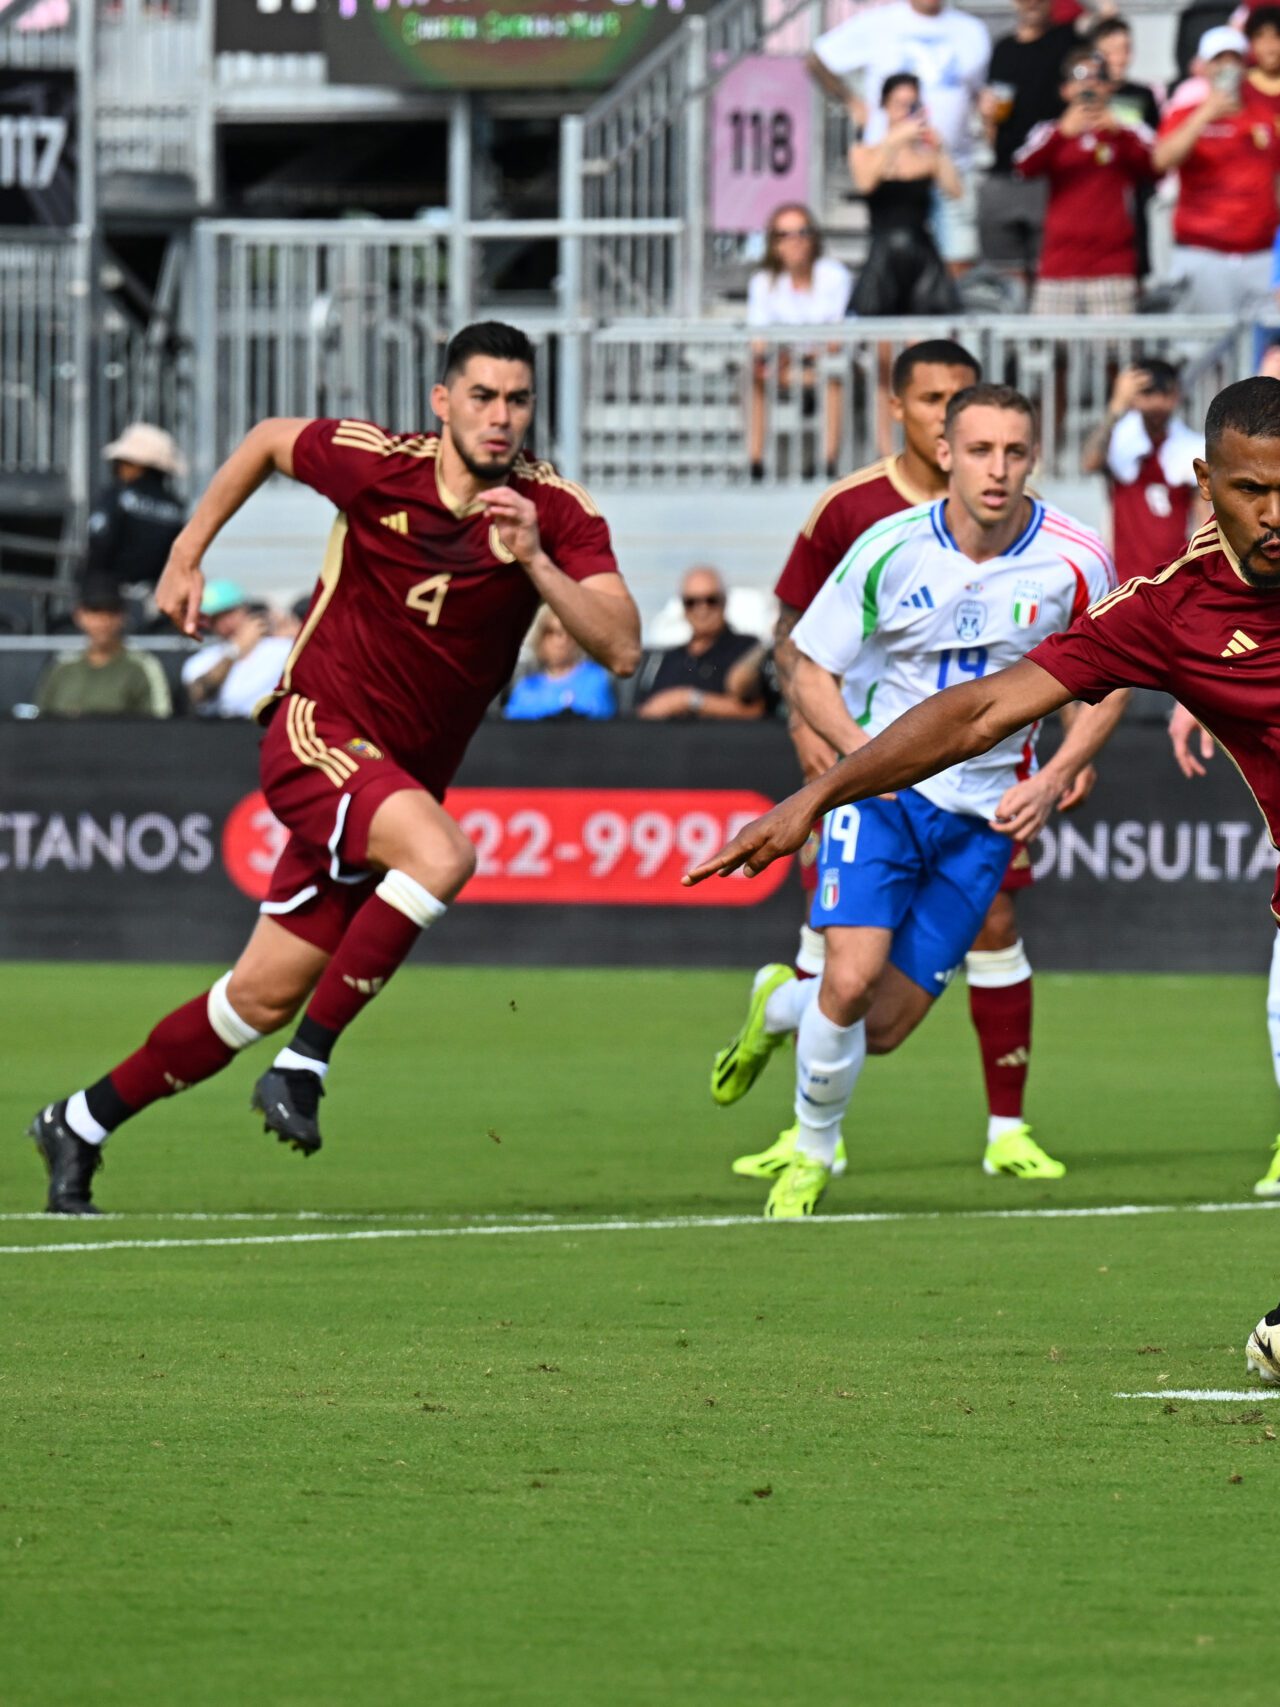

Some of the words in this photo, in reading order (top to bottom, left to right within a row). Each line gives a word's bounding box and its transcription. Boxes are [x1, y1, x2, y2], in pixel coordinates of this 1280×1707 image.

[0, 115, 67, 188] 117
[730, 111, 793, 175] 118
[405, 572, 452, 626] 4
[937, 648, 989, 690] 19
[0, 811, 213, 872] TANOS
[821, 803, 861, 864] 19
